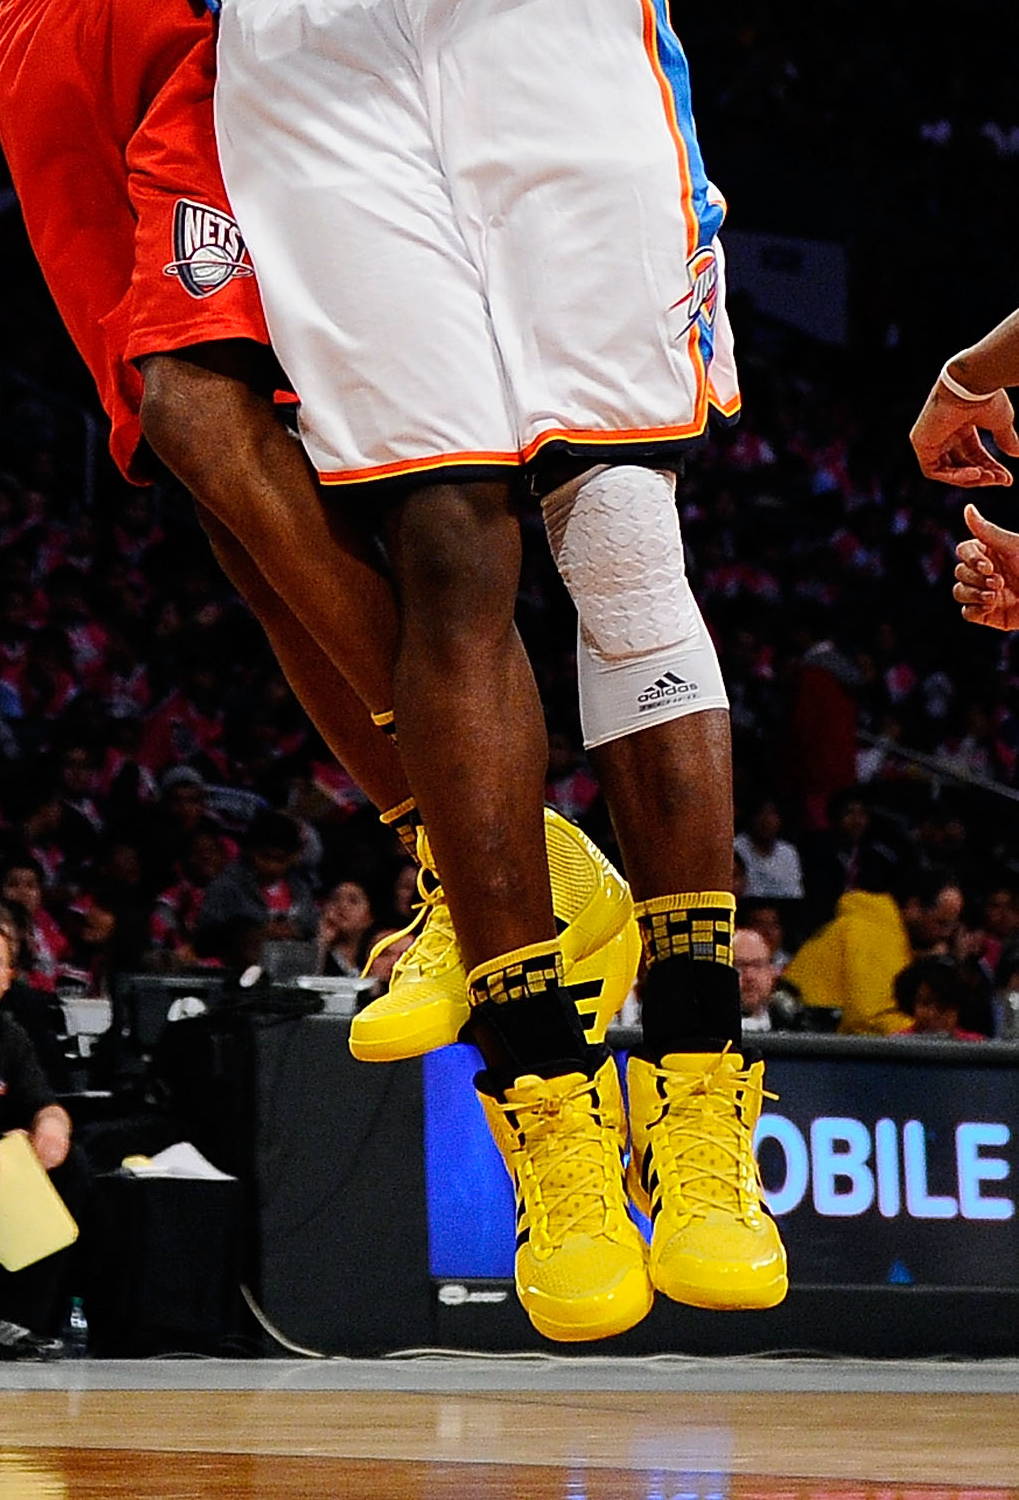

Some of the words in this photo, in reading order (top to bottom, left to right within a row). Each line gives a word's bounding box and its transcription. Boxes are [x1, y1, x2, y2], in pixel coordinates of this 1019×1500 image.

[185, 207, 241, 262] NETS
[637, 682, 698, 703] adidas
[752, 1113, 1016, 1220] OBILE
